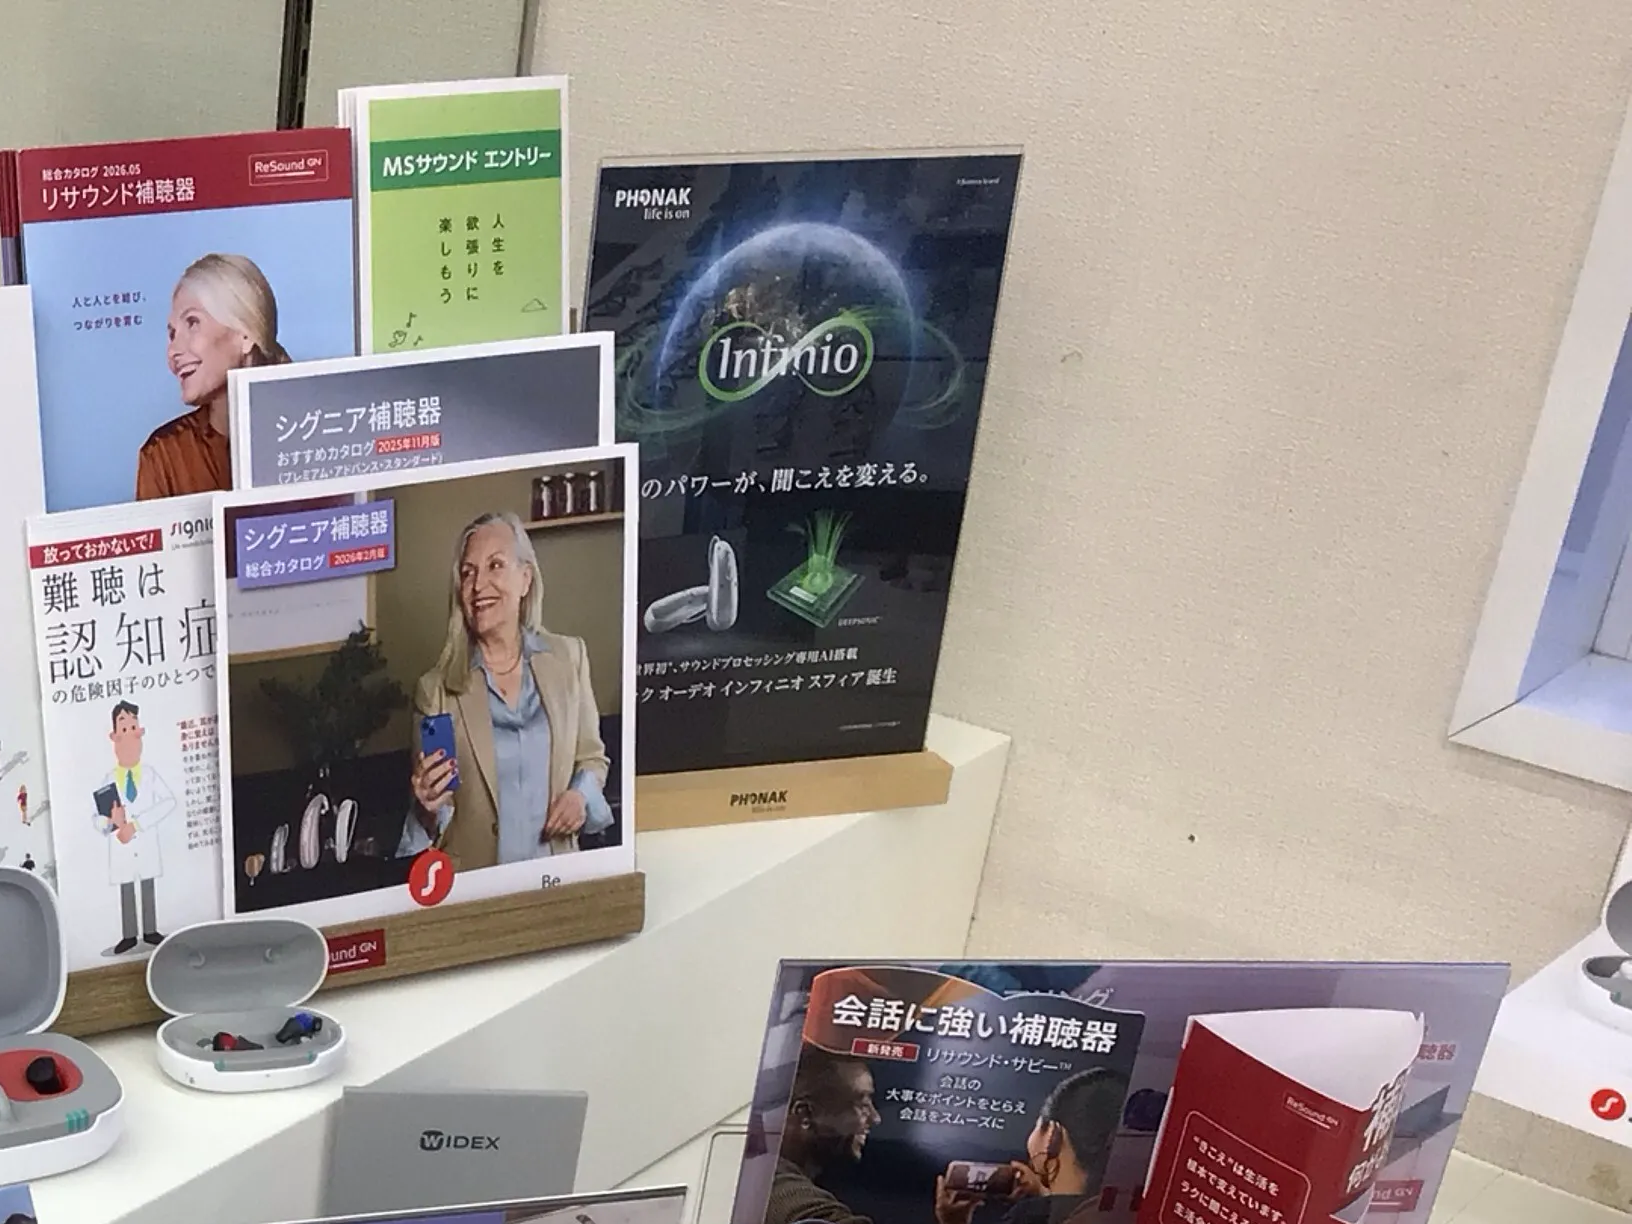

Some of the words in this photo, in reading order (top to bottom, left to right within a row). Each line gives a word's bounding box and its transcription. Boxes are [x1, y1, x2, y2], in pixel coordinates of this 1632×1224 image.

[42, 165, 99, 181] 総合カタログ
[103, 163, 141, 177] 2026.05
[254, 160, 305, 173] ReSound
[307, 158, 322, 167] GN
[383, 151, 477, 177] MSサウンド
[485, 147, 552, 169] エントリー
[42, 177, 196, 211] リサウンド補聴器
[615, 187, 692, 208] PHONAK
[644, 209, 663, 220] life
[675, 209, 690, 218] on
[466, 216, 480, 301] 欲張りに
[492, 213, 505, 276] 人生を
[439, 218, 453, 304] 楽しもう
[275, 396, 442, 442] シグニア補聴器
[277, 440, 376, 467] おすすめカタログ
[641, 461, 929, 500] のパワーが、聞こえを変える。
[244, 510, 389, 550] シグニア補聴器
[43, 532, 156, 565] 放っておかないで!
[245, 554, 326, 578] 総合カタログ
[42, 562, 166, 615] 難聴は
[45, 598, 218, 685] 認知症
[659, 683, 716, 701] オーデオ
[720, 676, 805, 698] インフィニオ
[730, 790, 789, 807] PHONAK
[831, 993, 1119, 1054] 会話に強い補聴器
[867, 1042, 905, 1058] 新発売
[939, 1073, 982, 1092] 会話の
[885, 1086, 1028, 1116] 大事なポイントをとらえ
[899, 1106, 1007, 1130] 会話をスムーズに
[419, 1129, 501, 1153] WIDEX
